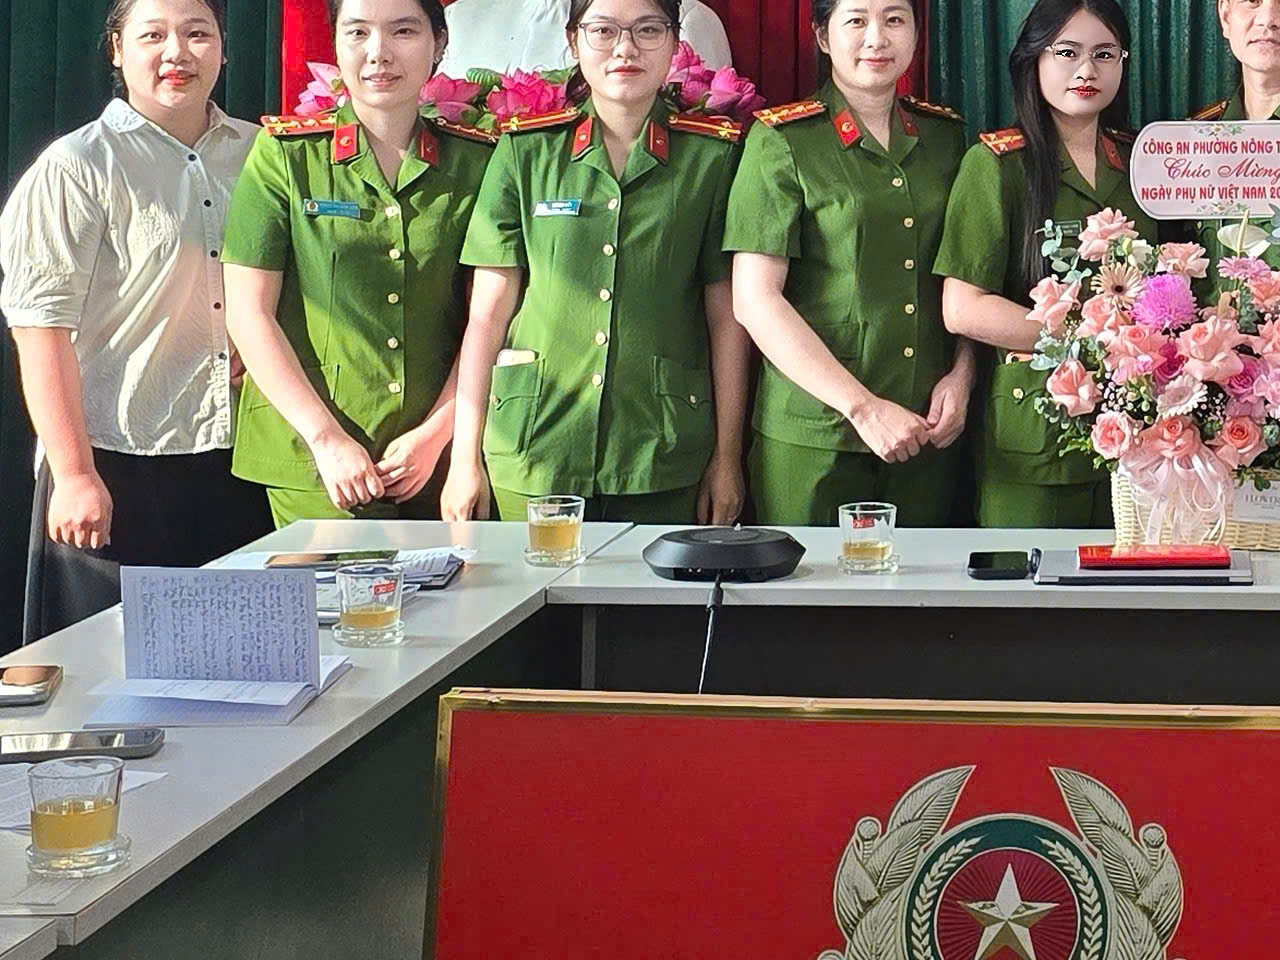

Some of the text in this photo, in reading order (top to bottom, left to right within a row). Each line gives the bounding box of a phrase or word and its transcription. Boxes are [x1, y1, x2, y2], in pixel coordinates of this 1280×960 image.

[1143, 138, 1173, 155] CÔNG
[1176, 141, 1190, 155] AN
[1193, 137, 1238, 155] PHƯỜNG
[1241, 137, 1273, 154] NÔNG
[1164, 157, 1211, 180] Chúc
[1141, 184, 1172, 200] NGÀY
[1175, 187, 1196, 204] PHỤ
[1199, 184, 1215, 200] NỮ
[1218, 183, 1239, 204] VIỆT
[1242, 186, 1267, 200] NAM
